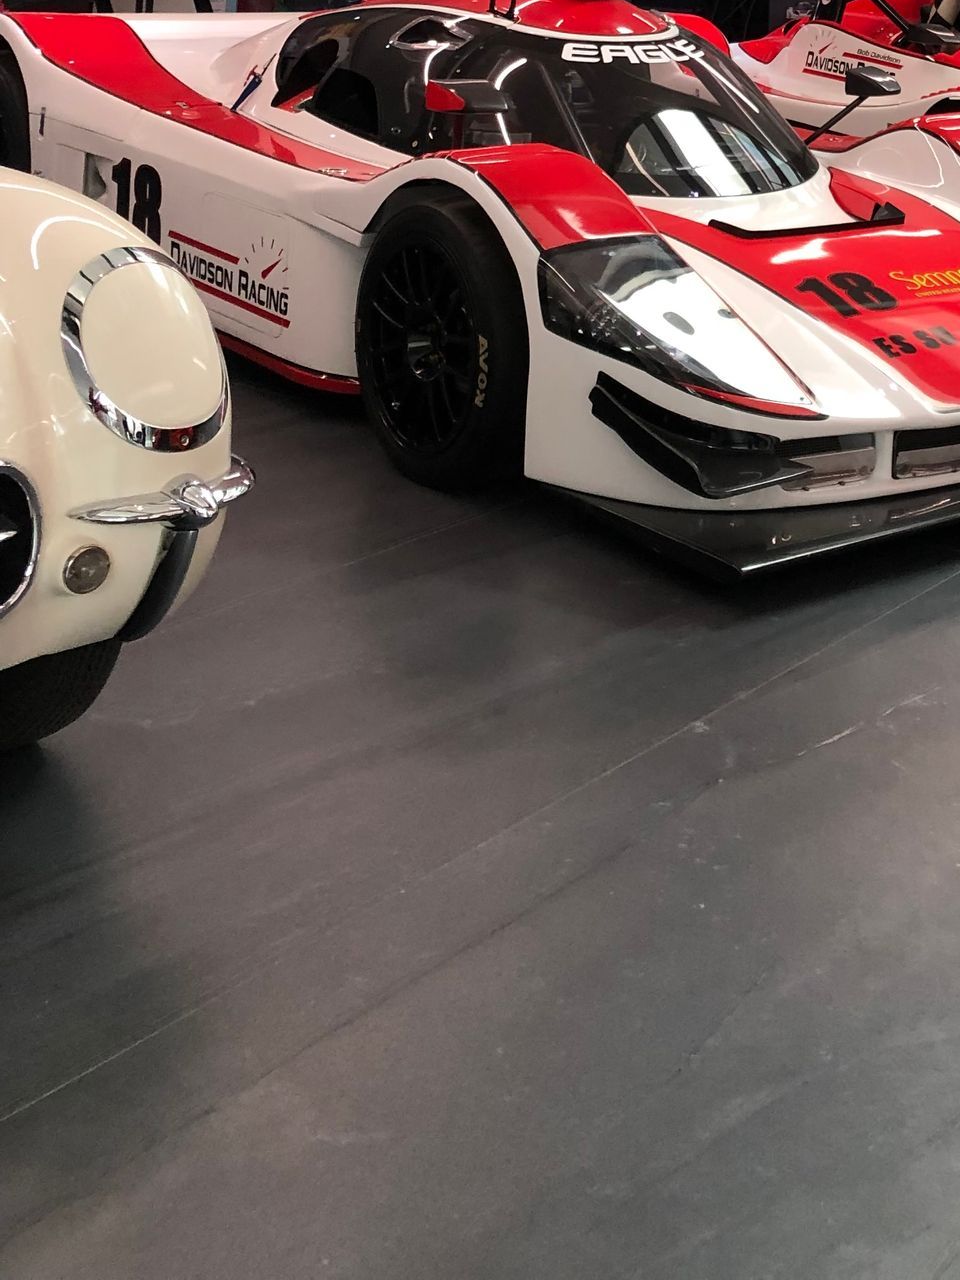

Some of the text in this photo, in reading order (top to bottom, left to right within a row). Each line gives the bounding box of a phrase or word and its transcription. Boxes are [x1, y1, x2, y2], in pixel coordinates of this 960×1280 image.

[561, 38, 705, 64] EAGLE
[857, 48, 901, 64] Bob Davidson
[112, 157, 162, 246] 18
[170, 241, 289, 316] DAVIDSON RACING
[794, 272, 898, 319] 18
[872, 335, 918, 359] ES
